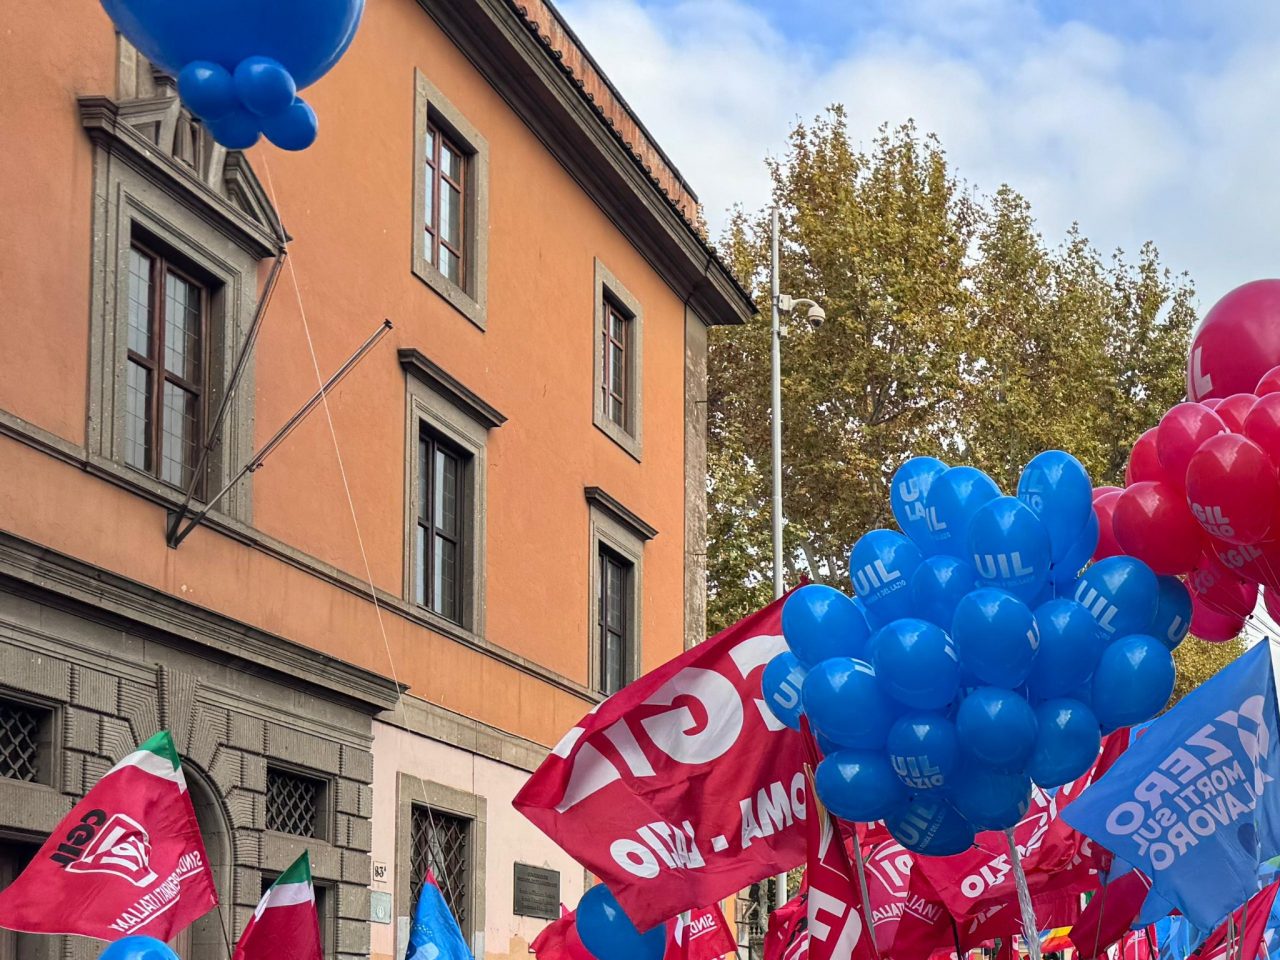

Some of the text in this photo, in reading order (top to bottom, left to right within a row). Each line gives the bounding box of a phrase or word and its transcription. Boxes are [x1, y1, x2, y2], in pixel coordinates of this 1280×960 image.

[1192, 503, 1229, 524] GIL
[852, 560, 901, 597] UIL
[975, 552, 1034, 579] UIL
[1073, 580, 1119, 634] UIL
[890, 755, 939, 777] UIL
